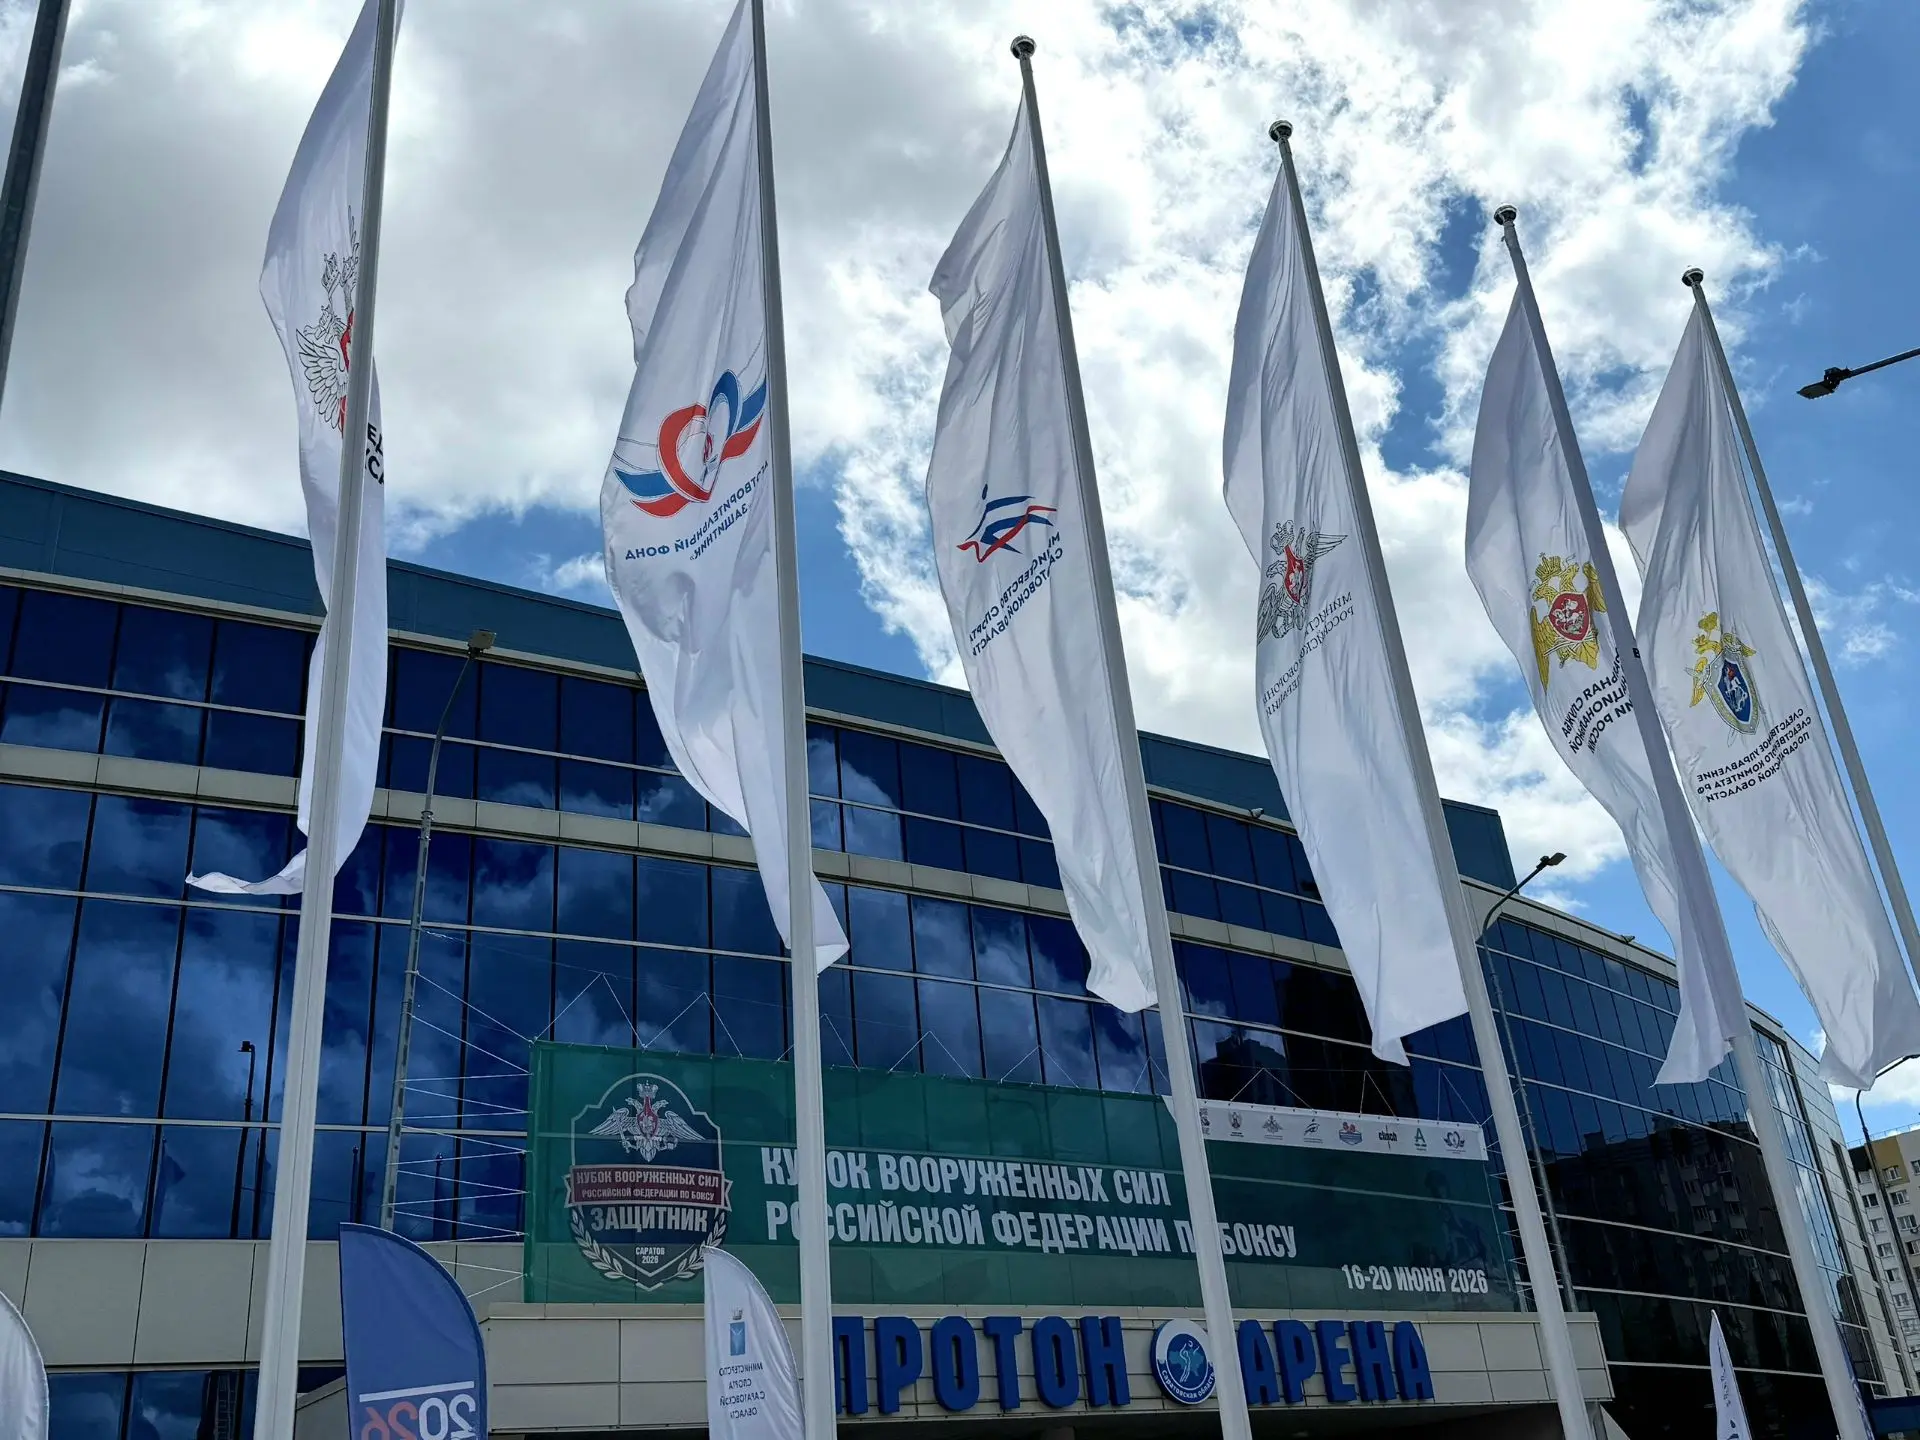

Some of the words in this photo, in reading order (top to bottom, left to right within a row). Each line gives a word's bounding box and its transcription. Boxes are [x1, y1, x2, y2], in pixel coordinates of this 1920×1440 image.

[576, 1170, 612, 1184] КУБОК
[615, 1170, 696, 1186] ВООРУЖЕННЫХ
[697, 1174, 719, 1188] СИЛ
[761, 1147, 871, 1189] КУОК
[878, 1154, 1110, 1203] ВООРУЖЕННЫХ
[1113, 1169, 1171, 1206] СИЛ
[582, 1187, 631, 1198] РОССИЙСКОЙ
[633, 1188, 679, 1200] ФЕДЕРАЦИИ
[680, 1190, 689, 1200] ПО
[691, 1191, 715, 1201] БОКСУ
[590, 1206, 708, 1233] ЗАЩИТНИК
[991, 1209, 1171, 1256] ФЕДЕРАЦИИ
[1217, 1222, 1297, 1258] БОКСУ
[635, 1247, 665, 1255] САРАТОВ
[1341, 1264, 1392, 1291] 16-20
[1393, 1266, 1446, 1293] ИЮНЯ
[1450, 1268, 1489, 1294] 2026
[832, 1315, 1130, 1415] ПРОТОН
[1237, 1319, 1434, 1406] АРЕНА
